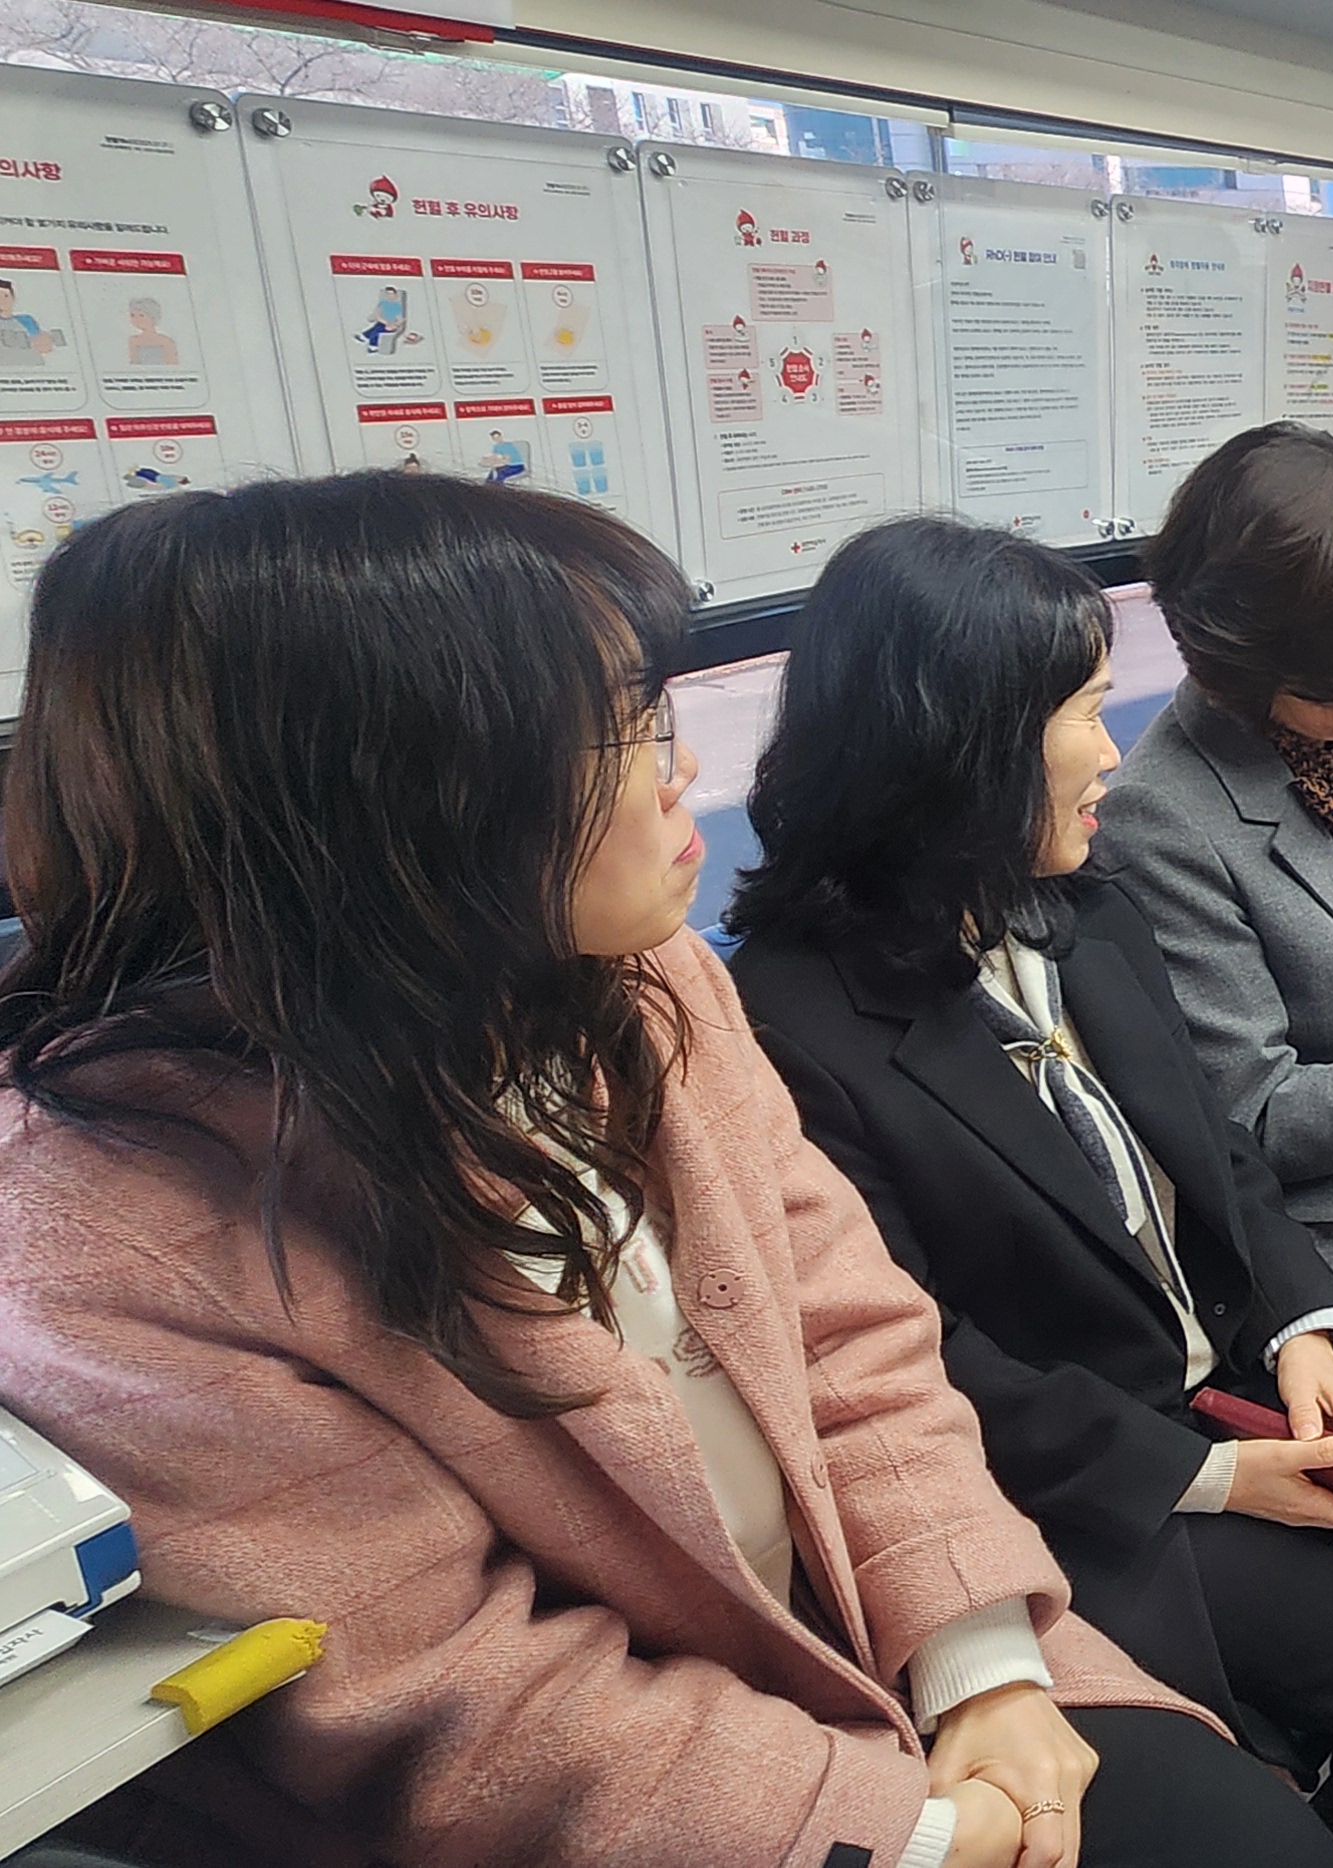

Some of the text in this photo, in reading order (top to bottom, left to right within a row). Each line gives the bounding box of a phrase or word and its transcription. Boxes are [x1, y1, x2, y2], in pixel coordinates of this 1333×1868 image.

[412, 198, 520, 220] 헌혈 후 유의사항
